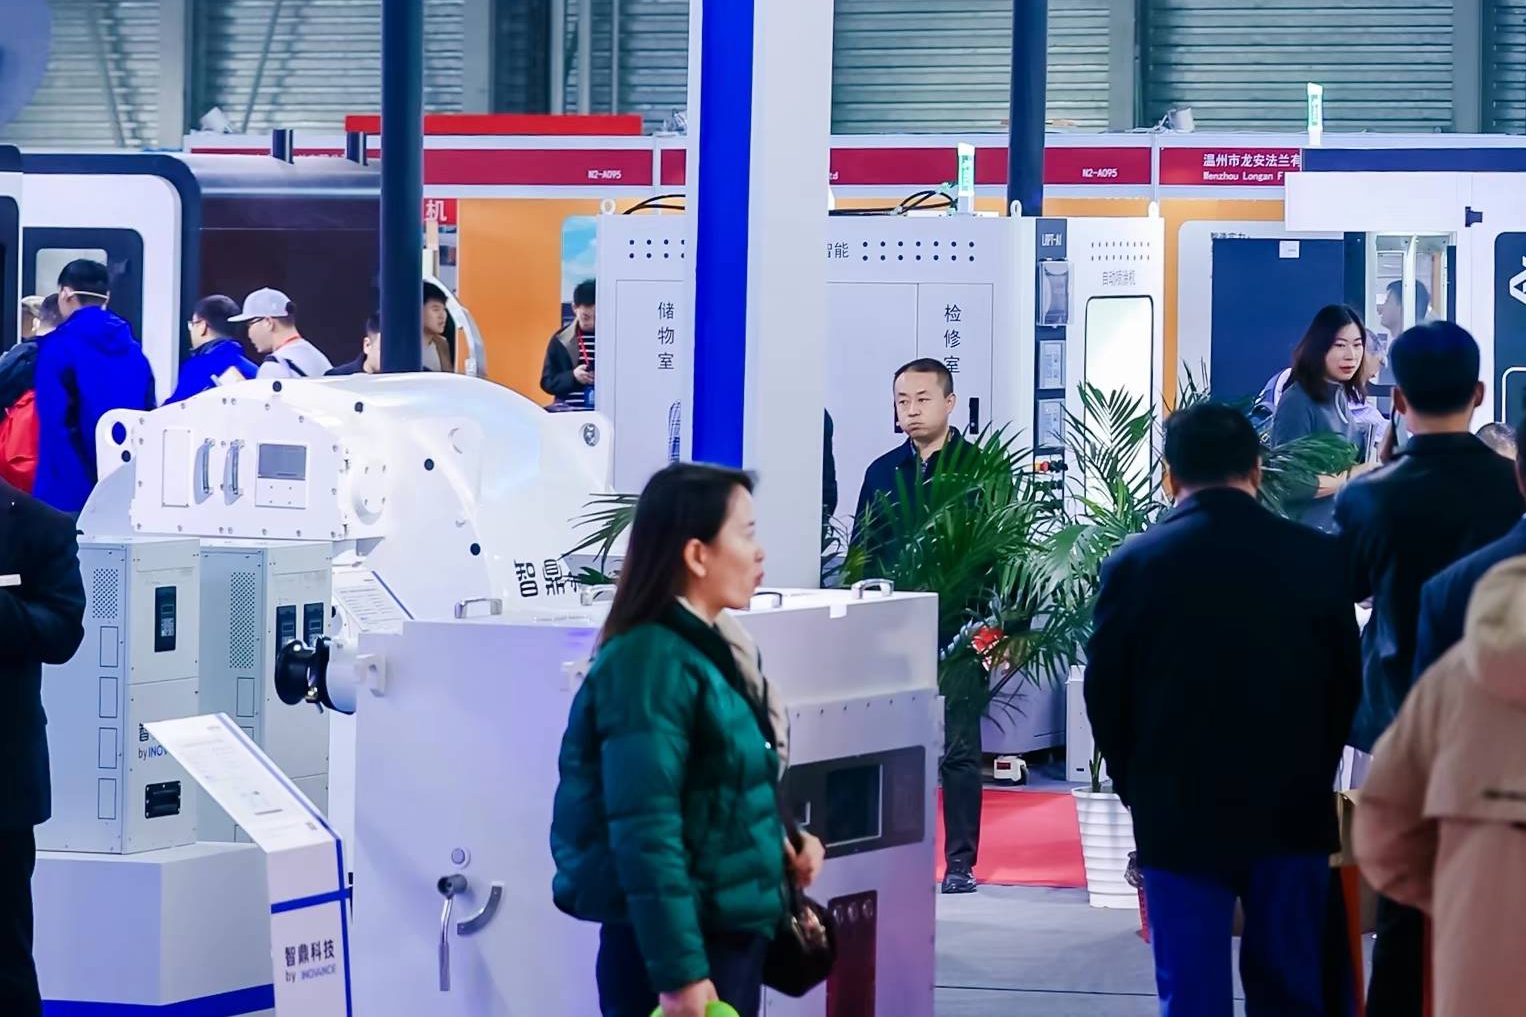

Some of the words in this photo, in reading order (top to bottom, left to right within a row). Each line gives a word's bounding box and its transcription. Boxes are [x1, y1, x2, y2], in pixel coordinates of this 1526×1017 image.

[1242, 171, 1273, 181] Longan
[657, 301, 675, 370] 储物室
[943, 303, 961, 373] 检修室
